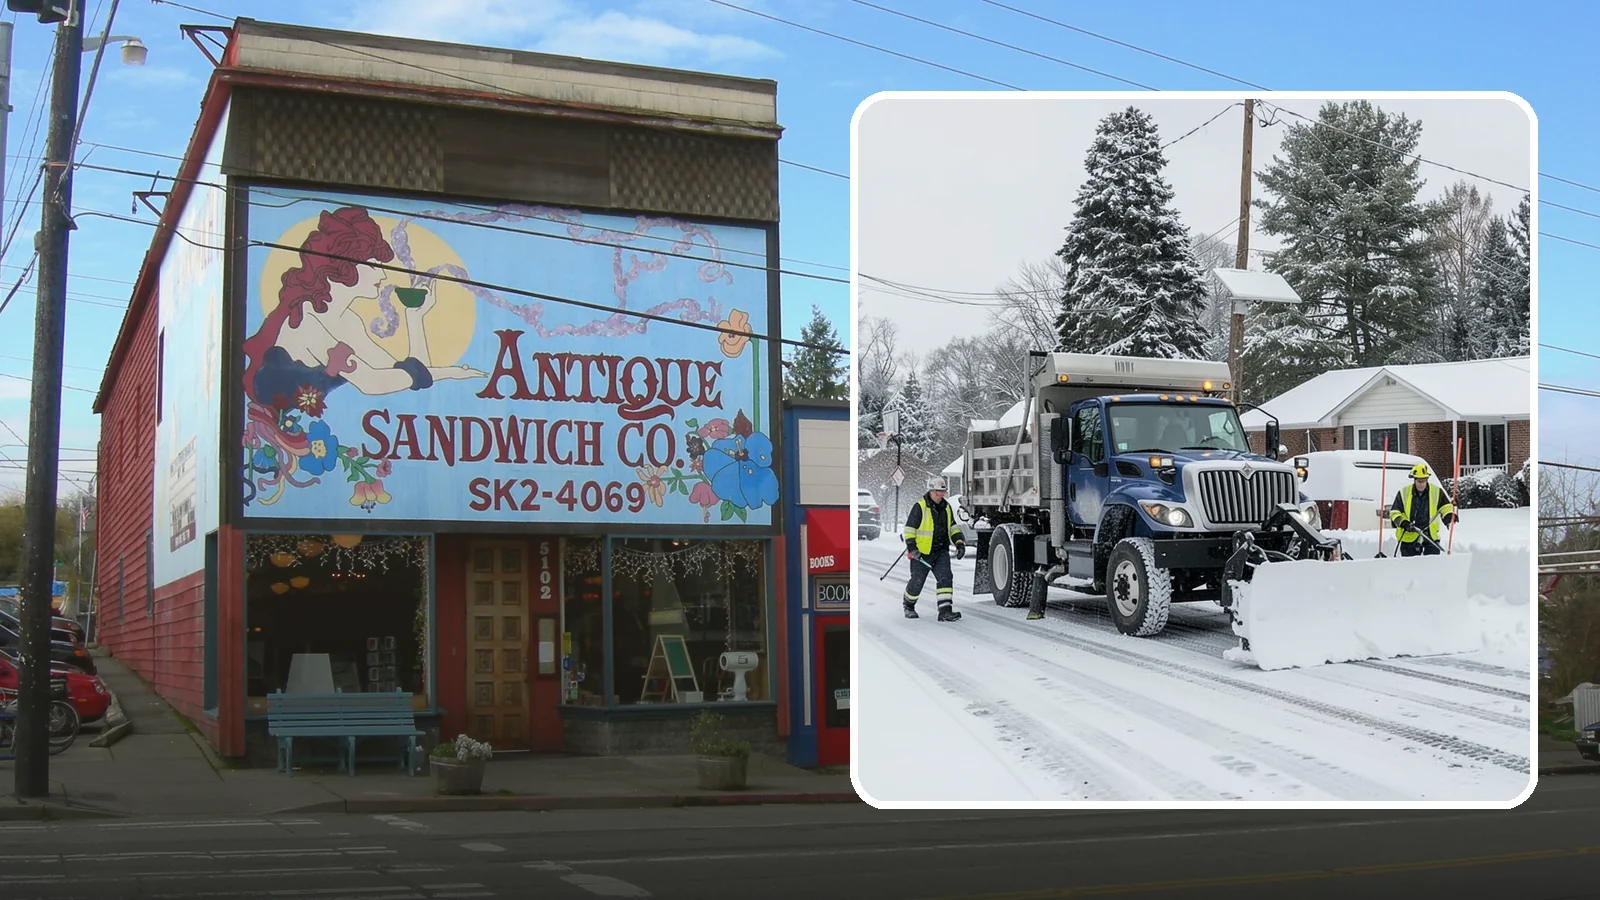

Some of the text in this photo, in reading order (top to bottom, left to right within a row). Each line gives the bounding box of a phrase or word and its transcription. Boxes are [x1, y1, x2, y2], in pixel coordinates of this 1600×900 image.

[476, 329, 724, 421] ANTIQUE
[361, 408, 685, 470] SANDWICH CO.
[468, 477, 647, 514] SK2-4069
[539, 541, 552, 600] 5102
[809, 555, 835, 569] BOOKS
